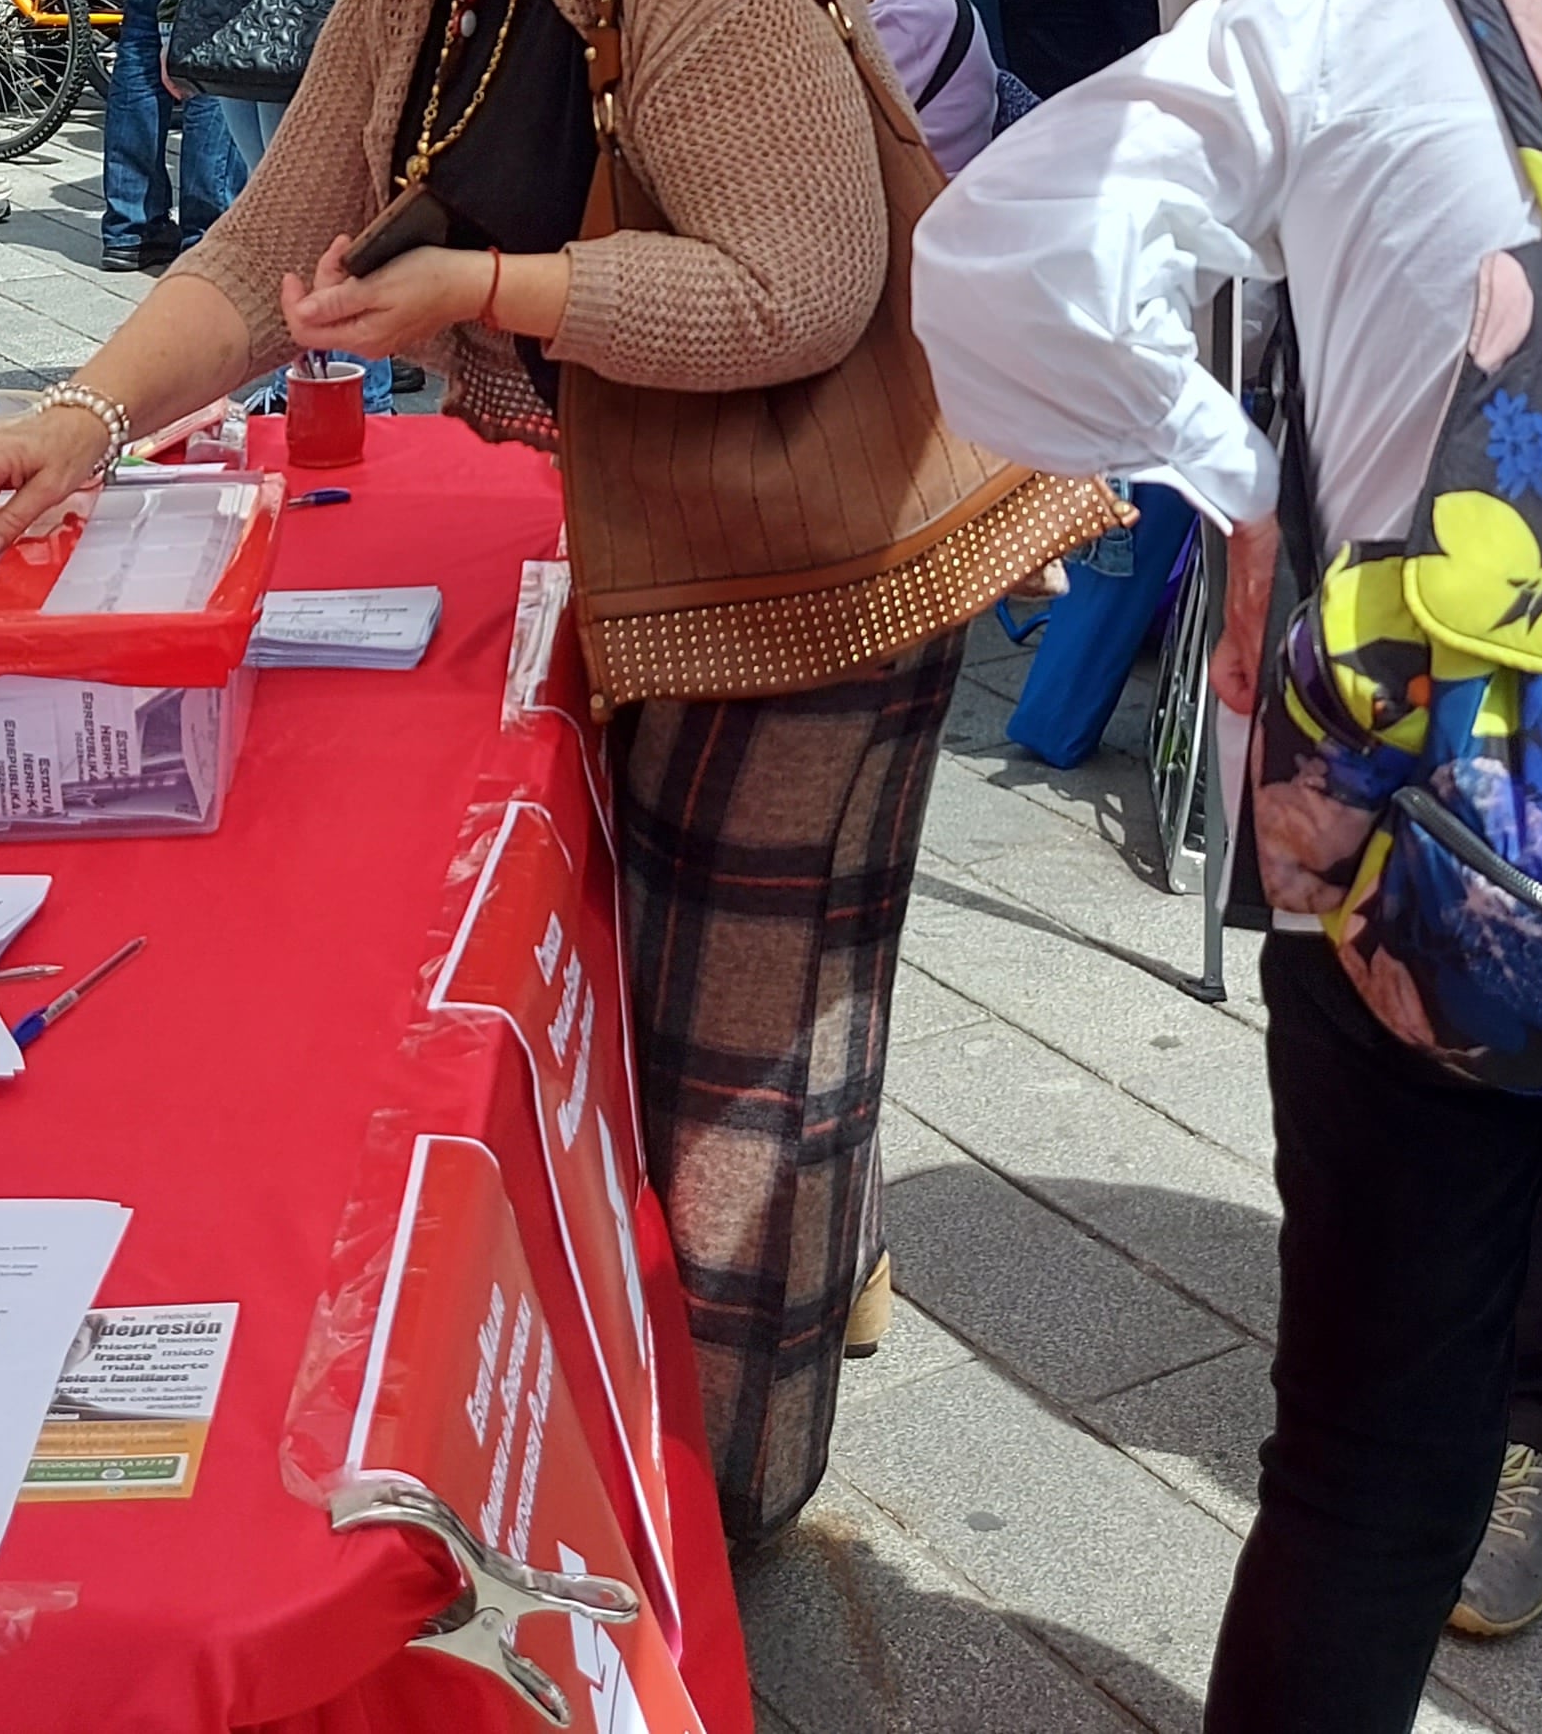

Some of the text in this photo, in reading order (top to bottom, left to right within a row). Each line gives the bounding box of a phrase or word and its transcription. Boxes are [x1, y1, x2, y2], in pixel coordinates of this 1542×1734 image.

[4, 718, 19, 811] ERREPUBLIKA
[38, 757, 58, 803] ESTATU
[100, 1319, 223, 1338] depresión
[91, 1335, 218, 1351] miseria insomnio
[94, 1347, 215, 1362] fracaso miedo
[101, 1361, 209, 1371] mala suerte
[110, 1371, 190, 1382] familiares
